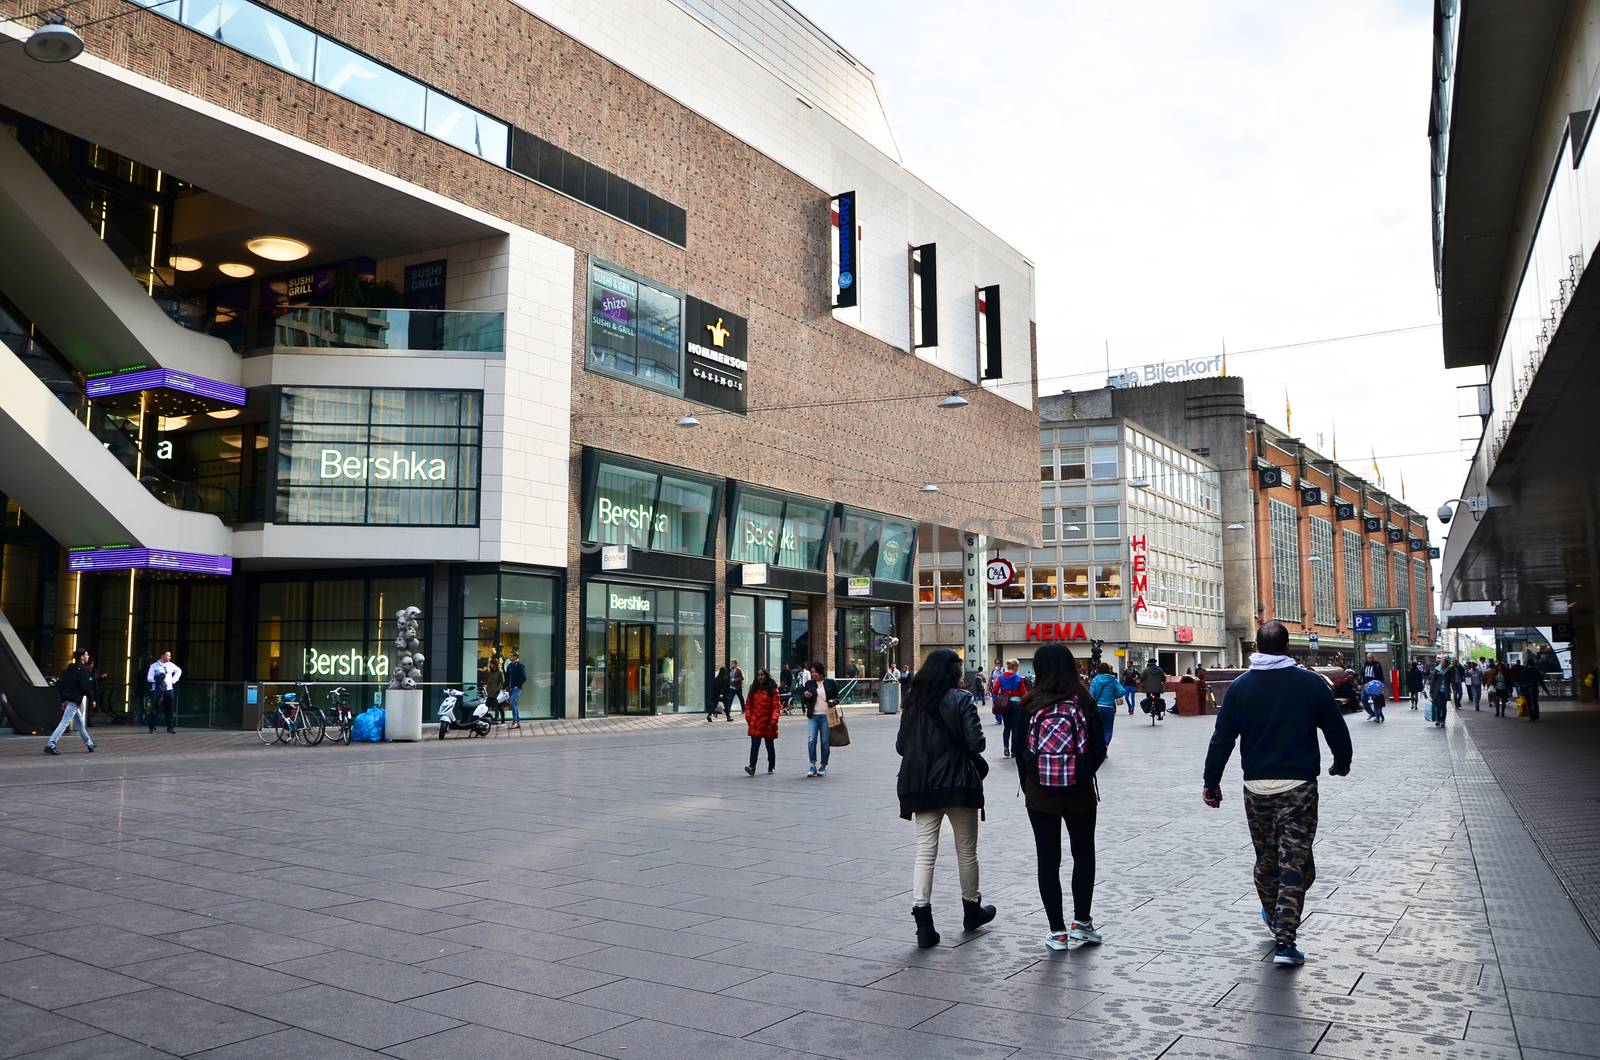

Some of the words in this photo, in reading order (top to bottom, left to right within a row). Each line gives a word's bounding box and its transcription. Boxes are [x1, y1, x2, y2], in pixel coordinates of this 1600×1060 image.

[288, 274, 314, 287] SUSHI
[411, 264, 442, 278] SUSHI
[288, 284, 313, 297] GRILL
[411, 277, 441, 290] GRILL
[593, 272, 613, 288] SUSHI
[617, 281, 635, 296] GRILL
[602, 297, 627, 311] shizo
[592, 316, 611, 328] SUSHI
[611, 322, 617, 330] &
[618, 325, 635, 336] GRILL
[687, 341, 748, 372] HOMMERSON
[1143, 354, 1221, 383] Bijenkorf
[320, 449, 446, 480] Bershka
[599, 497, 669, 533] Bershka
[746, 521, 796, 550] Berska
[603, 552, 626, 563] Bershka
[986, 566, 1007, 581] C&A
[1132, 534, 1148, 613] HEMA
[610, 594, 650, 612] Bershka
[967, 537, 976, 668] SPUIMARKT
[1355, 617, 1363, 627] P
[1025, 623, 1088, 641] HEMA
[303, 648, 389, 676] Bershka
